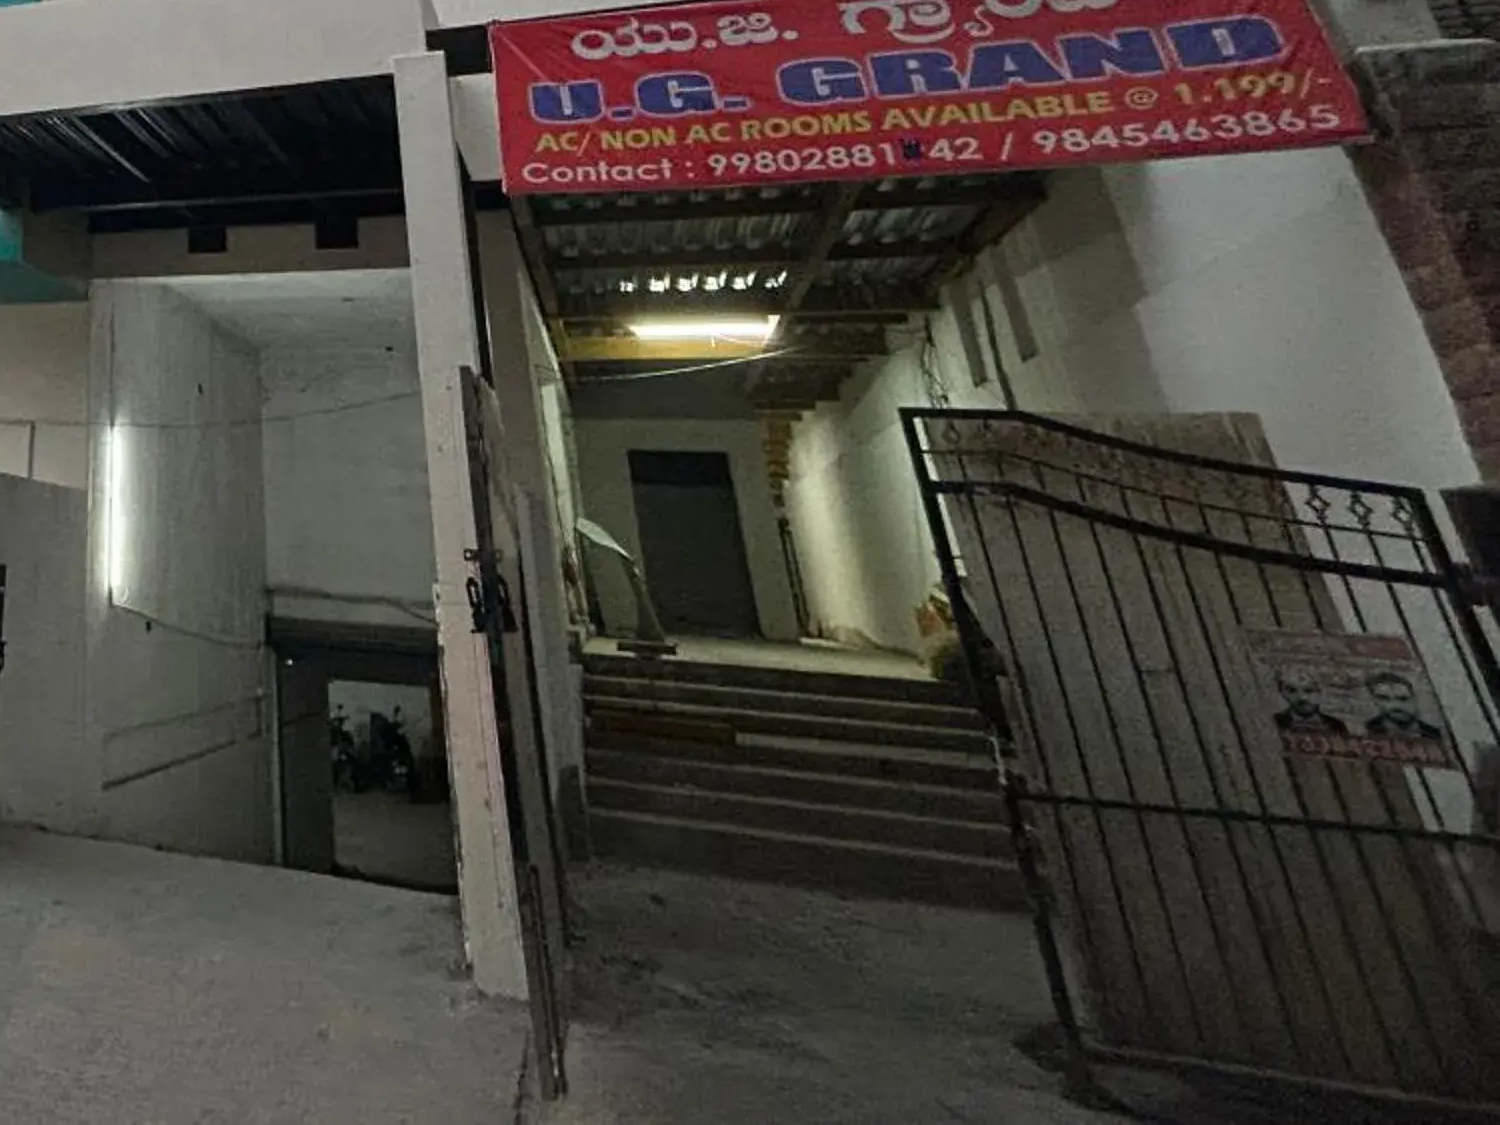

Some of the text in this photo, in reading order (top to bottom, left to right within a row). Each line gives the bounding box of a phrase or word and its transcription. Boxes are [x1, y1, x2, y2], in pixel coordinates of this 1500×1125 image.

[528, 13, 1292, 123] U.G. GRAND
[521, 157, 672, 184] Contact
[706, 137, 983, 177] 9980288142
[1000, 131, 1014, 162] /
[1032, 103, 1342, 154] 9845463865
[535, 130, 591, 157] AC/
[600, 126, 677, 150] NON
[684, 121, 732, 144] AC
[740, 111, 872, 140] ROOMS
[882, 91, 1115, 130] AVAILABLE
[1123, 86, 1159, 109] @
